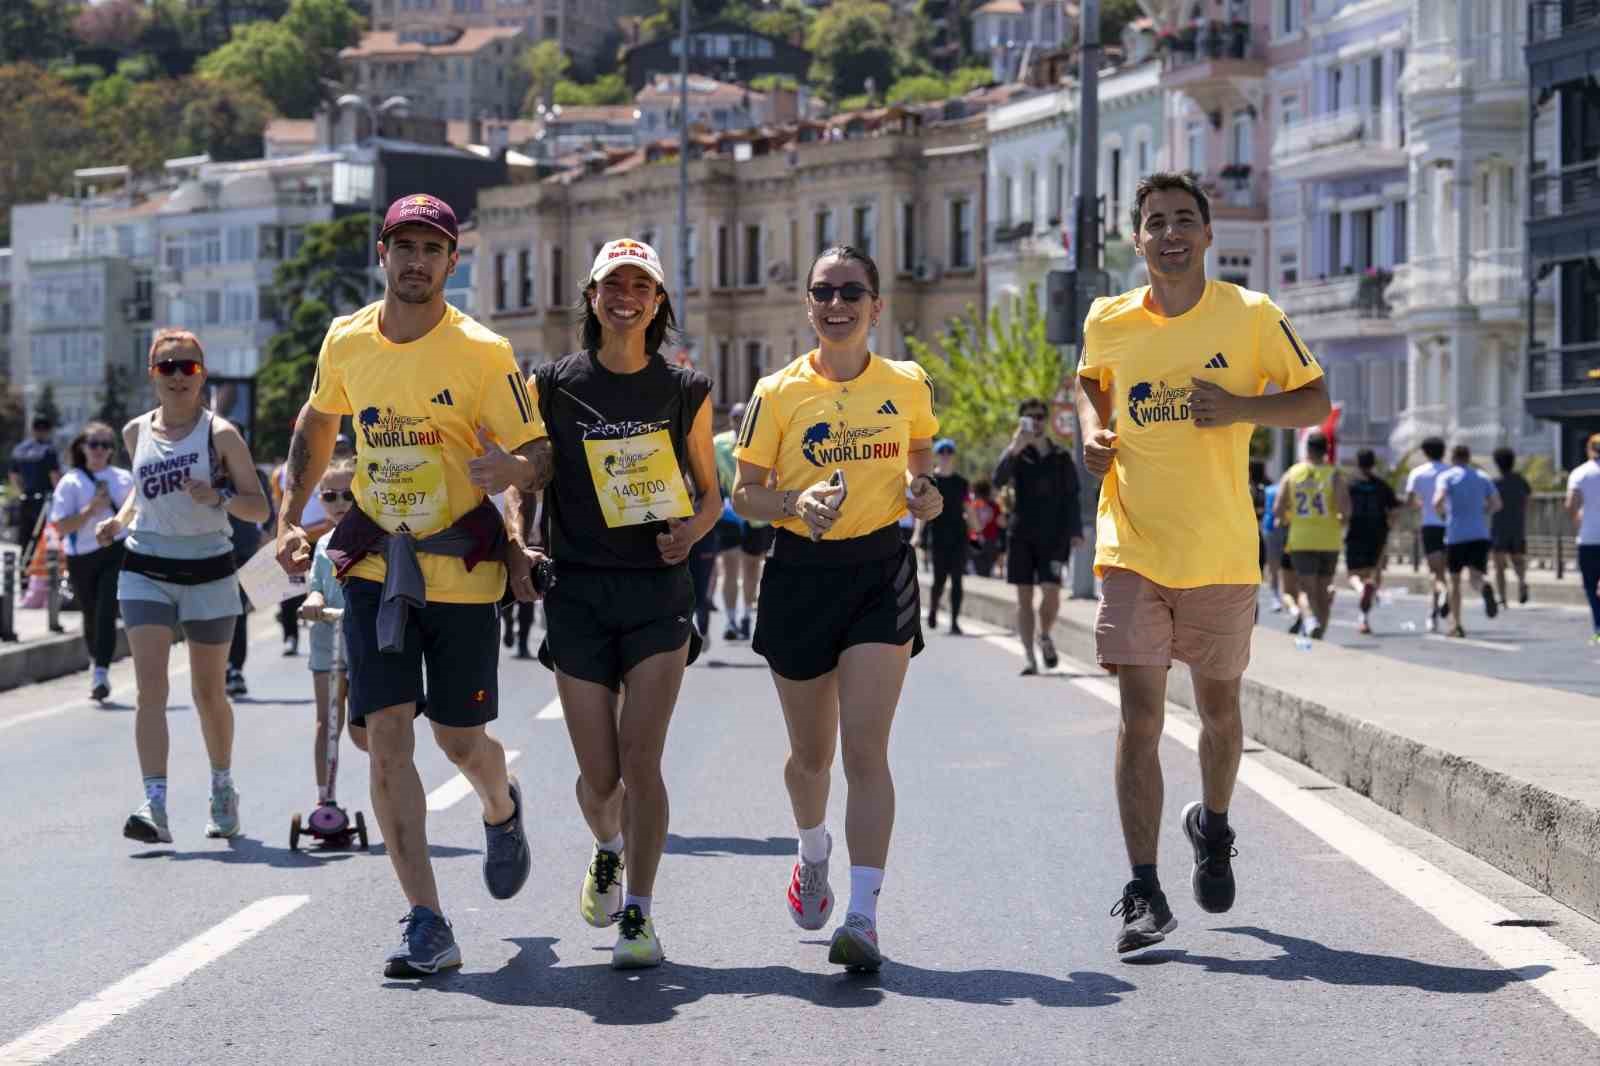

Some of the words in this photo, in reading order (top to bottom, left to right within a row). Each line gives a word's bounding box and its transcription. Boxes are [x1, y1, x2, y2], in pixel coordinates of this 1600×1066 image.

[608, 249, 628, 260] Red
[629, 249, 648, 261] Bull
[1152, 388, 1185, 401] WINGS
[1141, 404, 1188, 422] WORLD
[830, 427, 869, 440] WINGS
[836, 437, 858, 447] LIFE
[139, 453, 199, 479] RUNNER
[612, 478, 666, 497] 140700
[373, 489, 427, 506] 133497
[1295, 490, 1329, 518] 24
